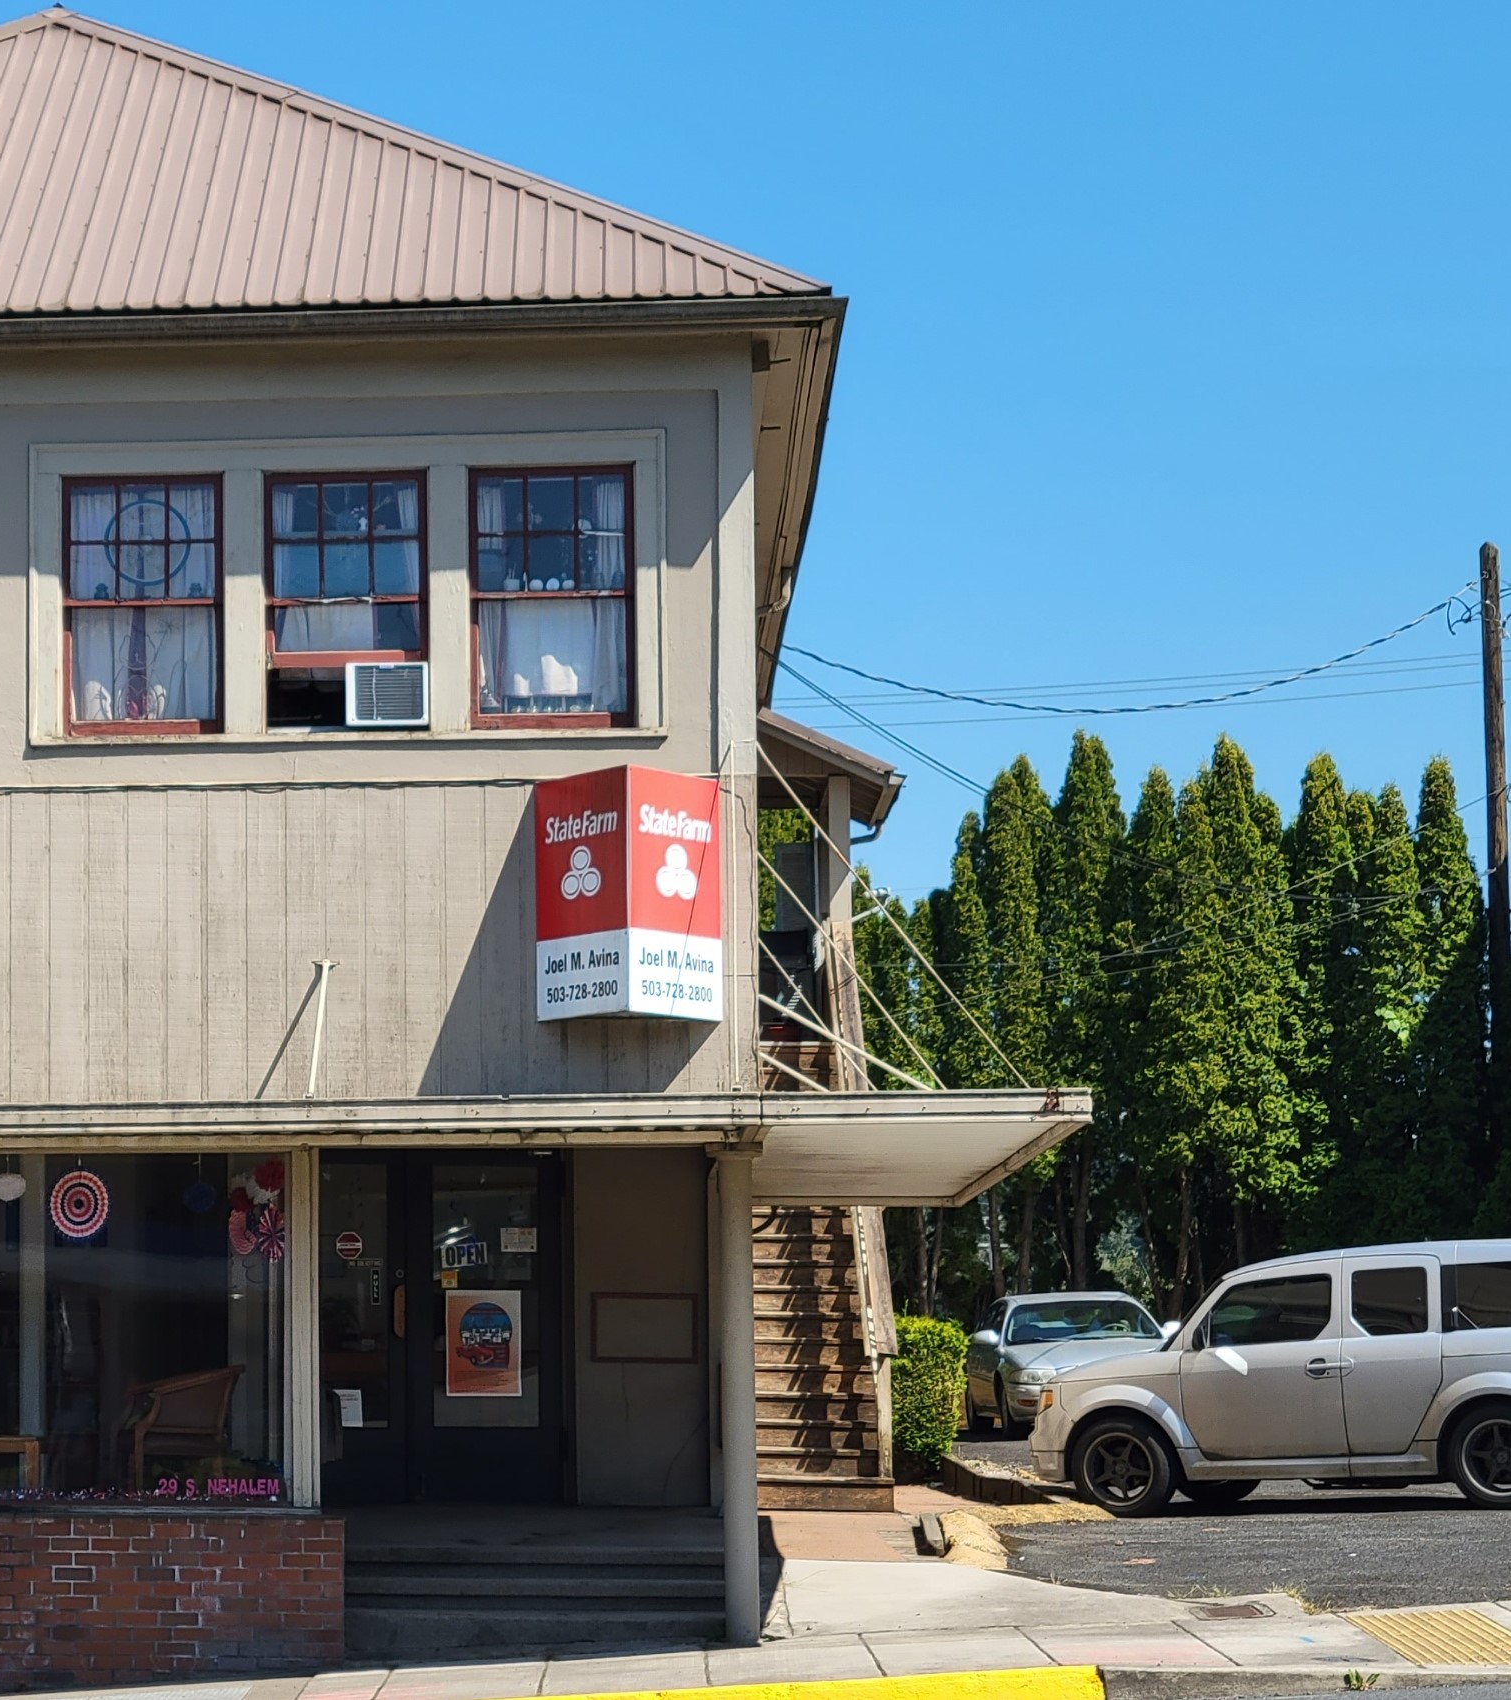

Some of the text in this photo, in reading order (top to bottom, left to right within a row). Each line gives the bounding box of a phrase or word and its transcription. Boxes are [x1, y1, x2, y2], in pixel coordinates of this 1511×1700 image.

[545, 810, 618, 844] StateFarm
[639, 803, 712, 843] StateFarm
[544, 949, 620, 976] Joel M. Avina
[639, 947, 714, 974] Joel M. Avina
[547, 979, 618, 1004] 503-728-2800
[642, 980, 713, 1002] 503-728-2800
[446, 1243, 485, 1266] OPEN
[158, 1478, 280, 1497] 29 S. NEHALEM
